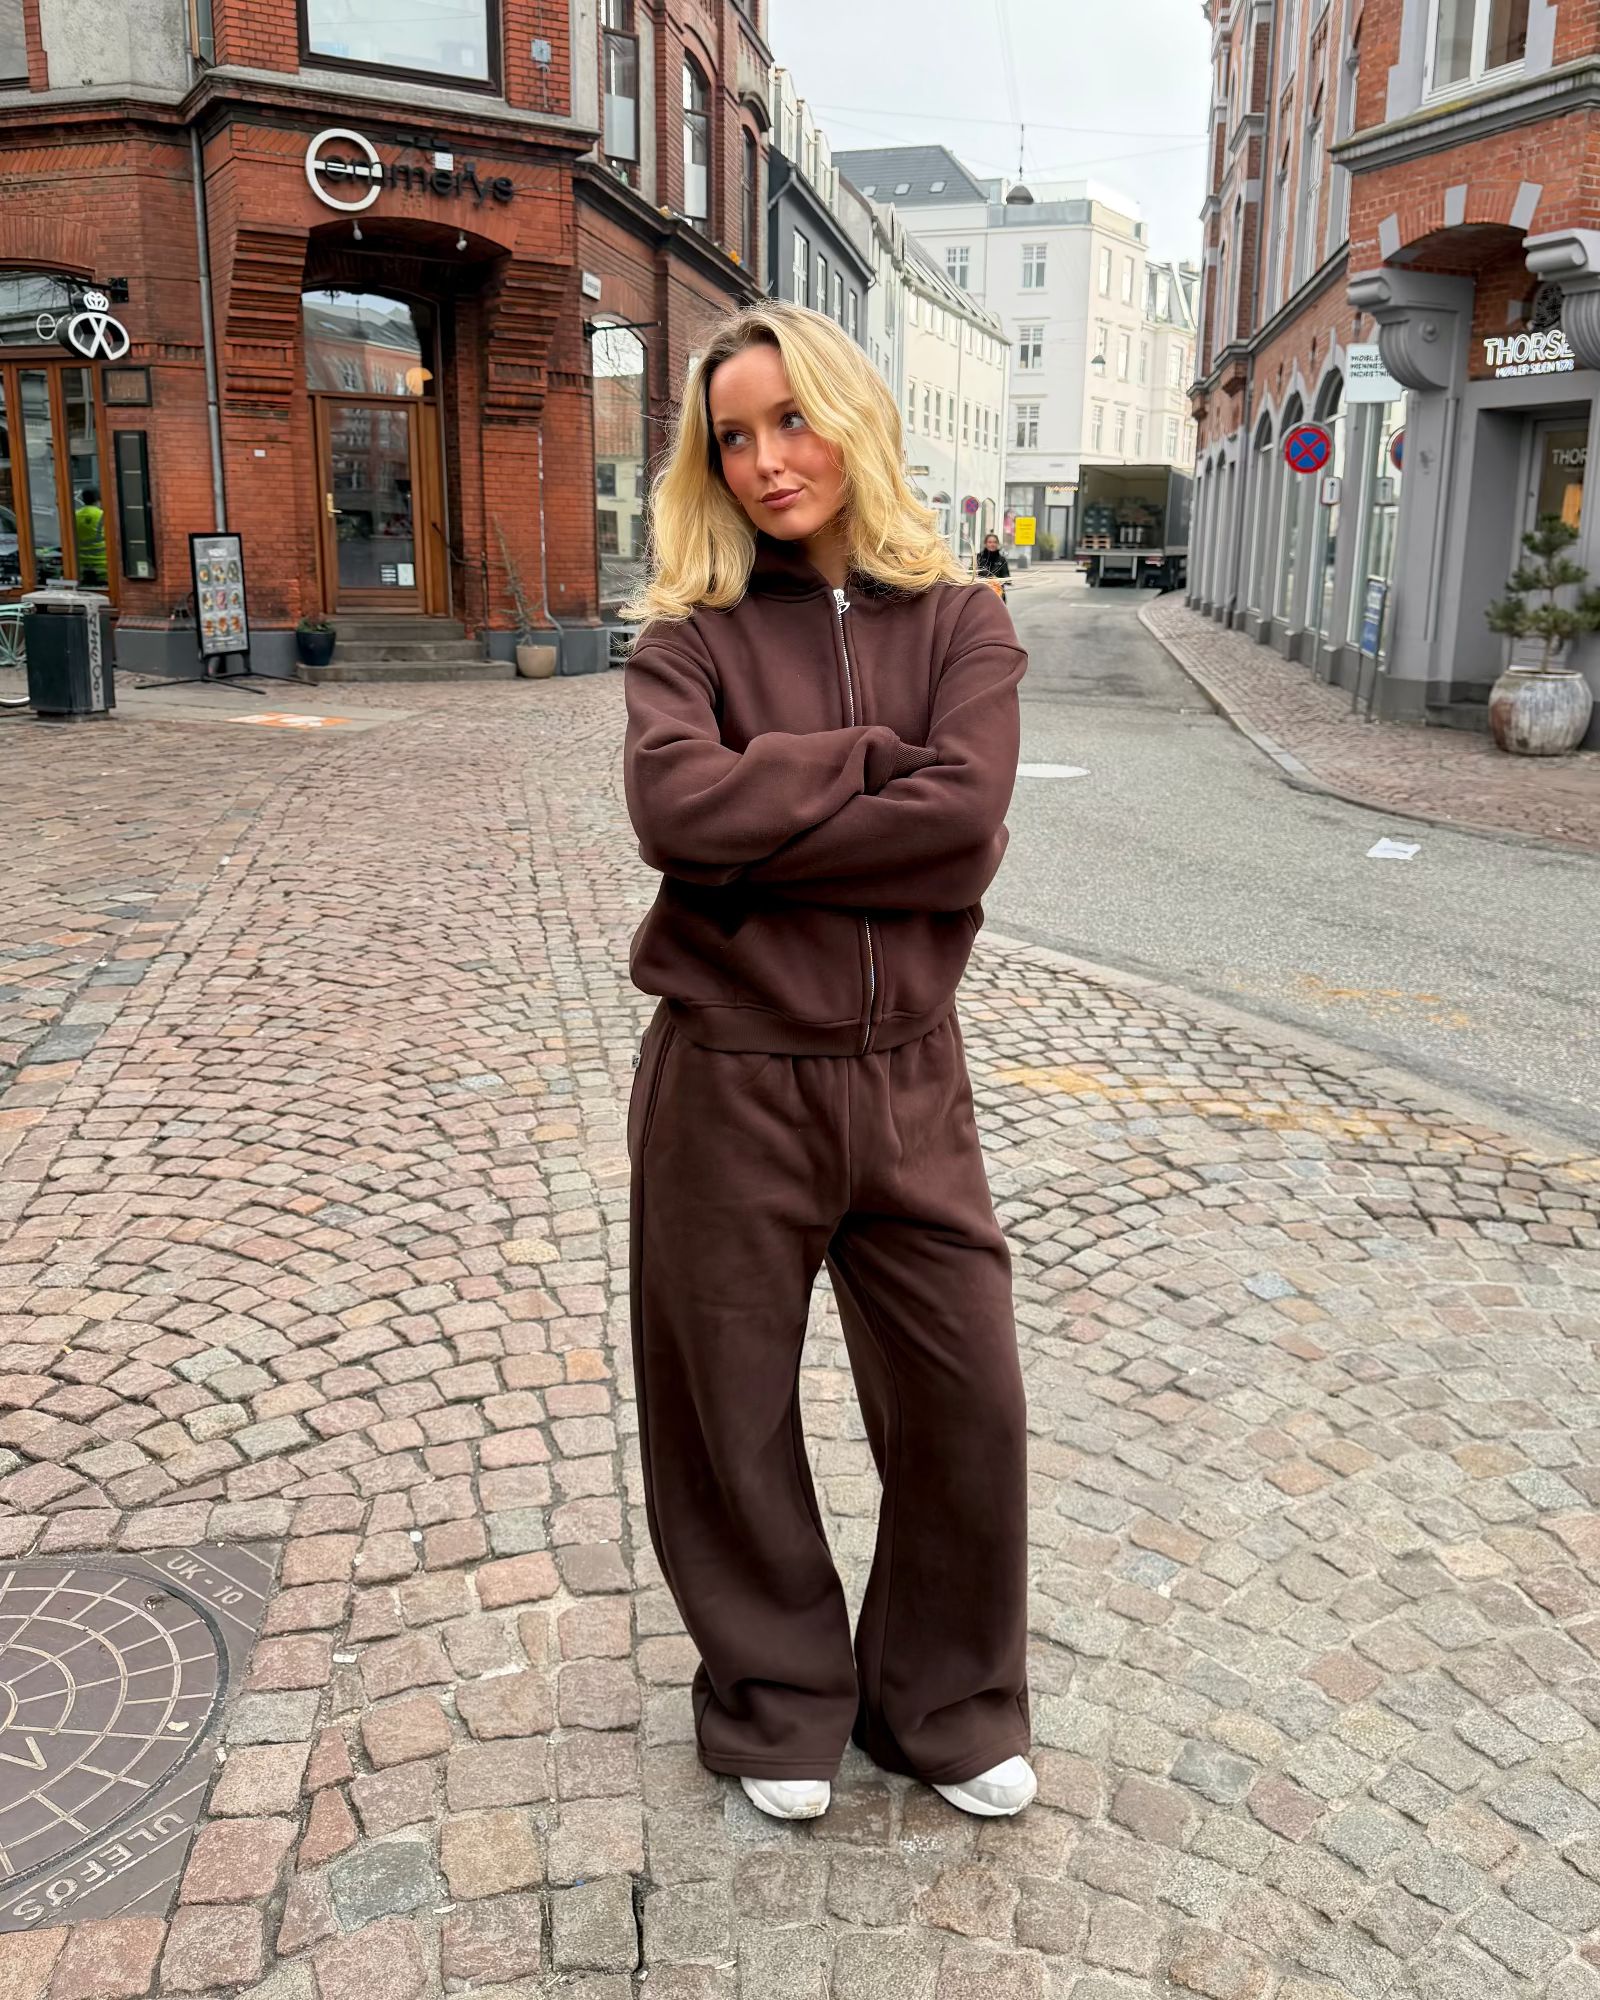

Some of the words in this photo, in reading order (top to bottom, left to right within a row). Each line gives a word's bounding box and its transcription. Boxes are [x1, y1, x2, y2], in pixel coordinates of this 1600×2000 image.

[324, 155, 515, 208] emmerys
[167, 1555, 206, 1580] UK
[212, 1585, 244, 1604] 10
